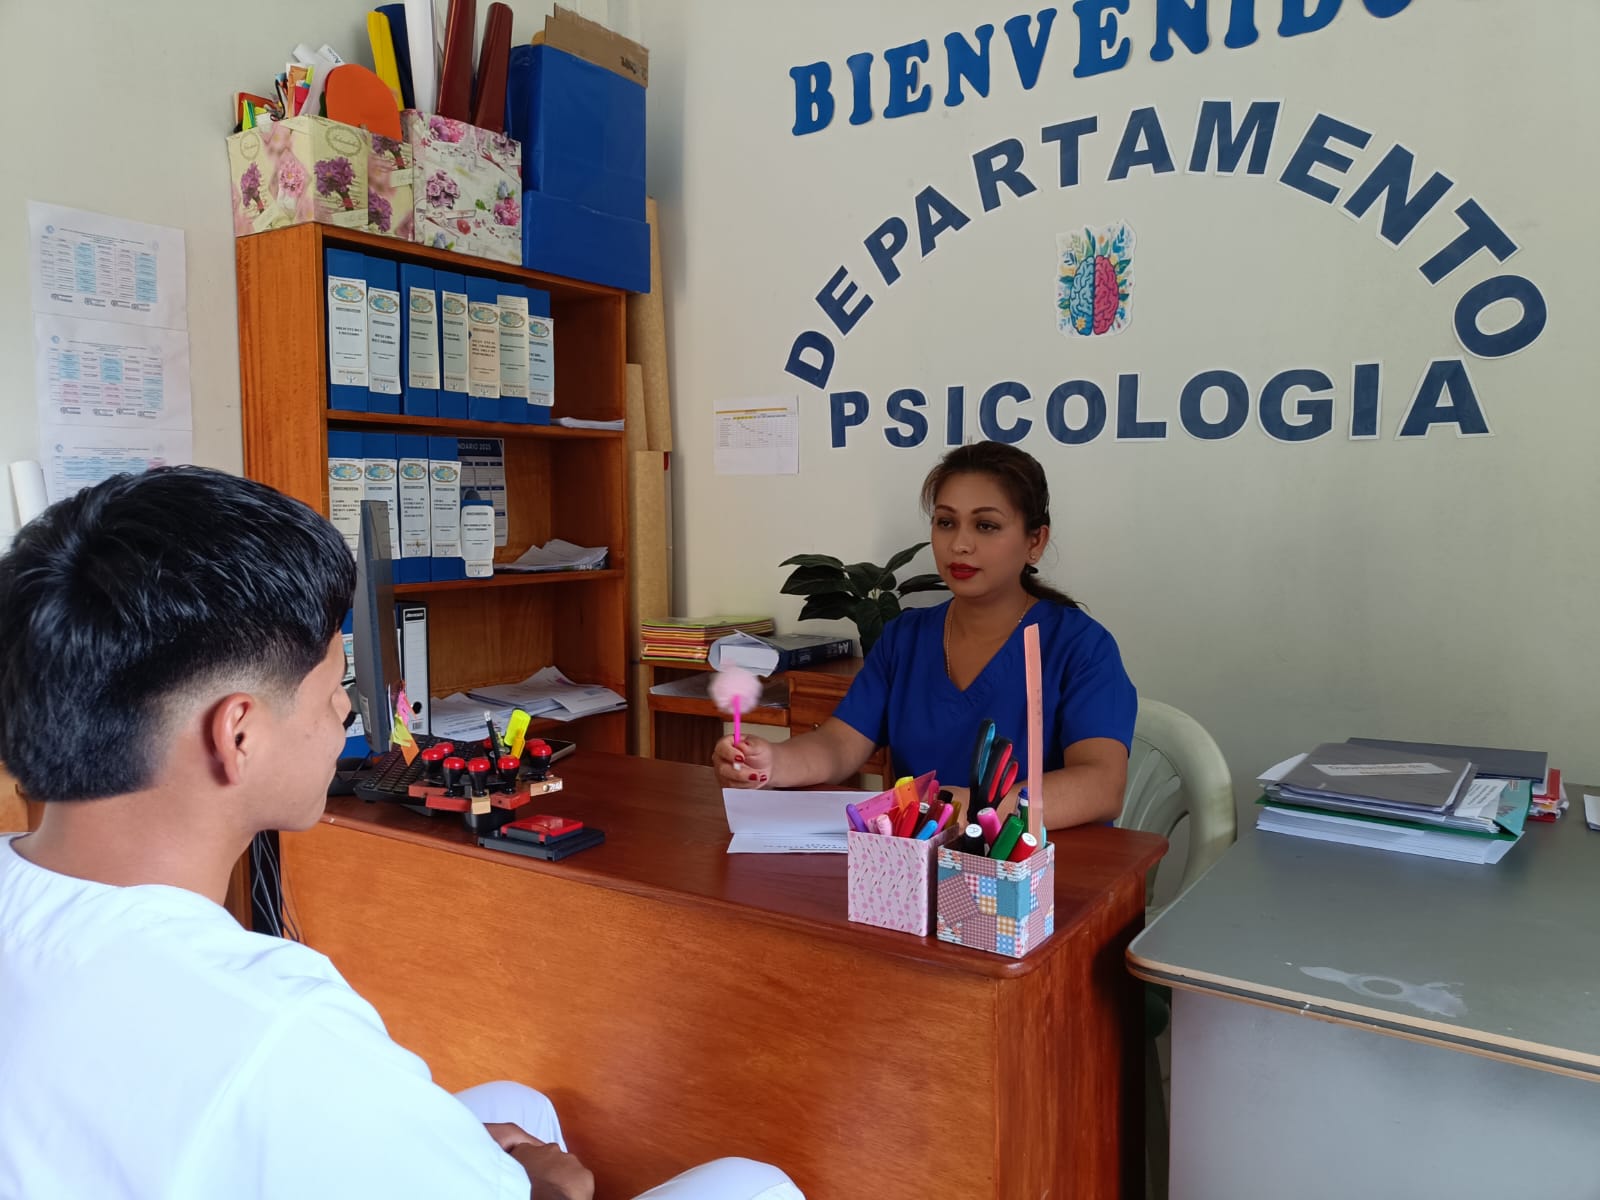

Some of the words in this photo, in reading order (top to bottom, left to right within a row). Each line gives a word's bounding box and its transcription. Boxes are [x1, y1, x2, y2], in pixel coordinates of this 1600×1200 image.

[788, 0, 1413, 136] BIENVENI
[784, 101, 1548, 389] DEPARTAMENTO
[829, 361, 1489, 448] PSICOLOGIA
